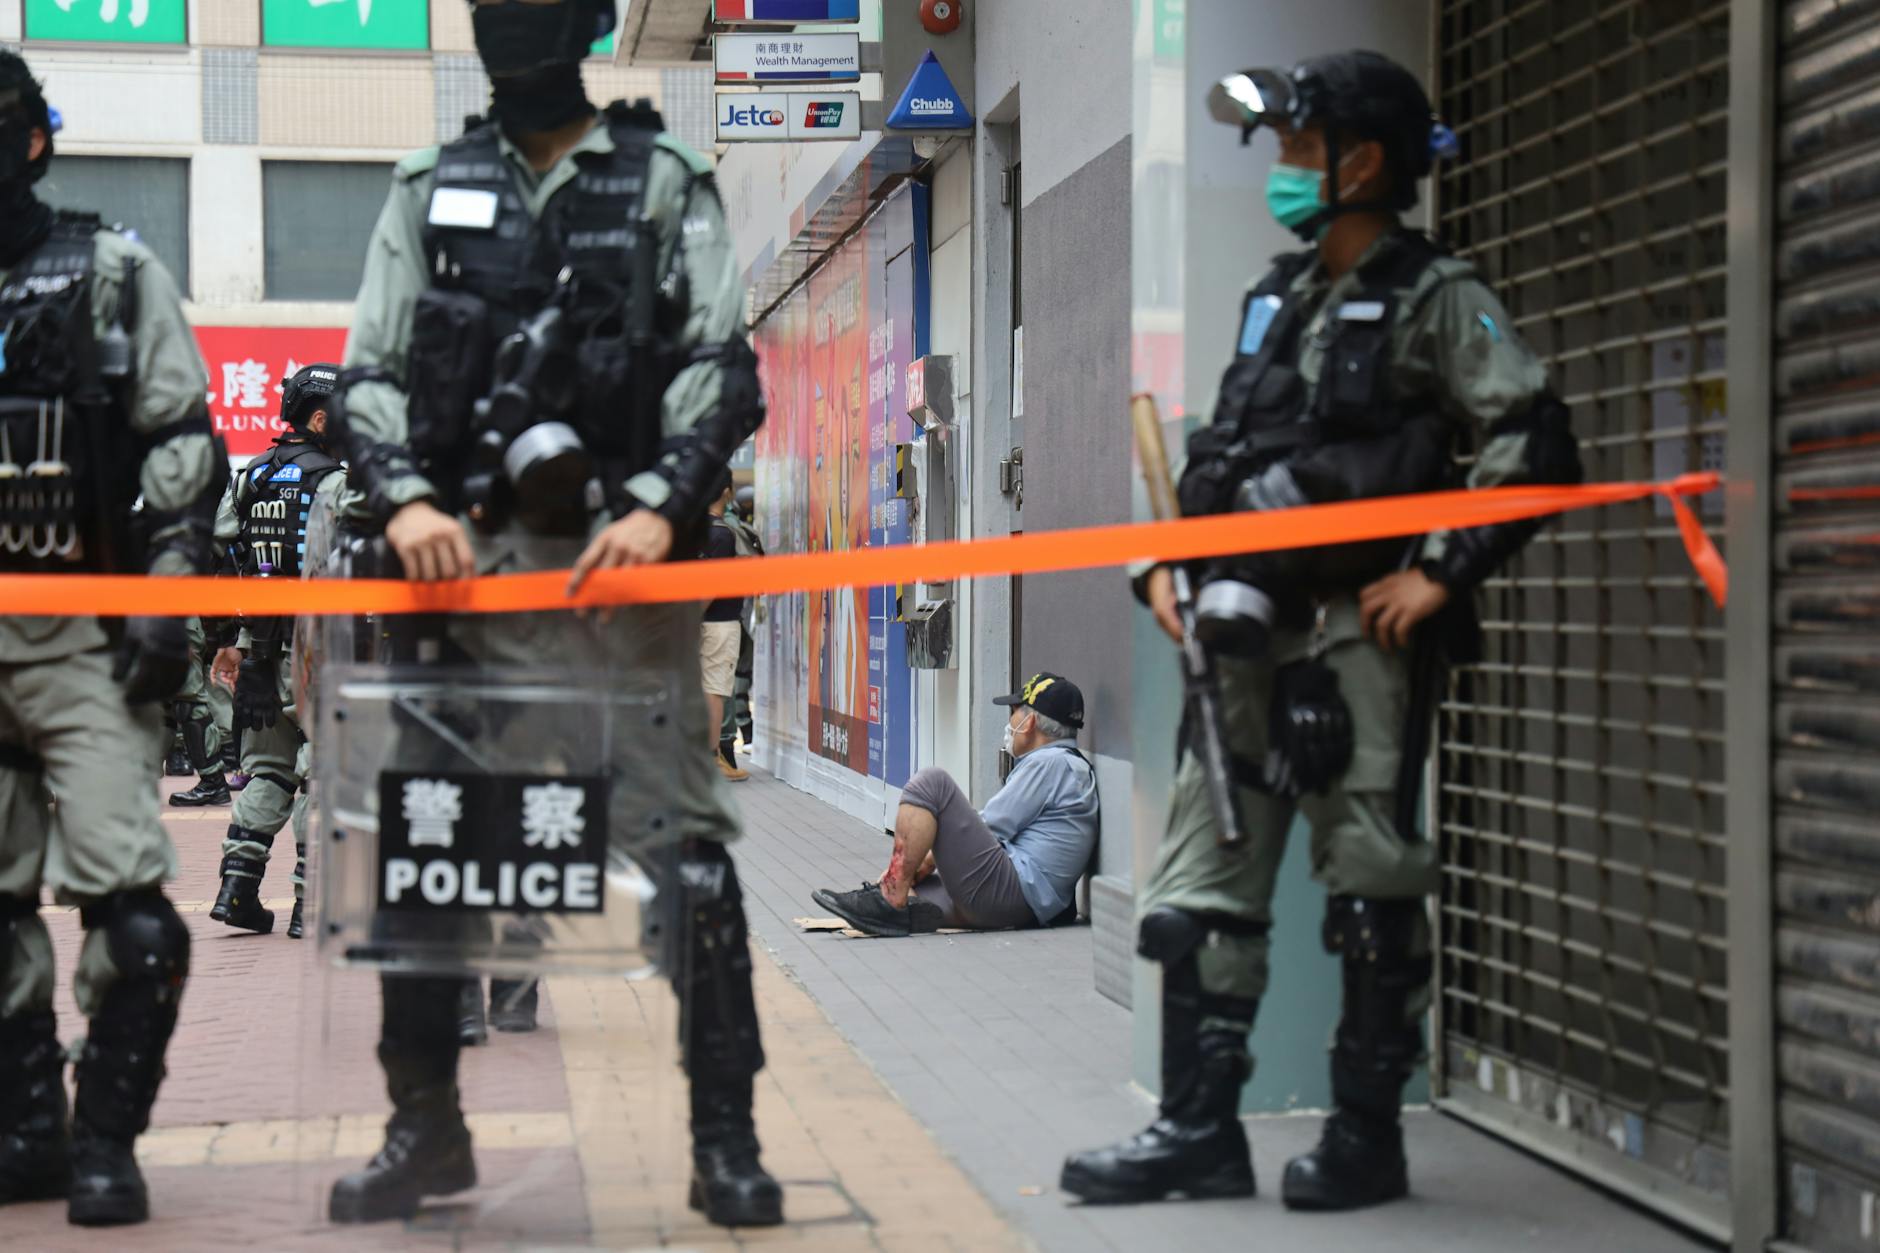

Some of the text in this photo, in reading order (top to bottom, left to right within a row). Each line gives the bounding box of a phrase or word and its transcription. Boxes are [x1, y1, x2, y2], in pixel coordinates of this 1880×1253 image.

[755, 42, 803, 54] 南商理財
[755, 55, 855, 67] Wealth Management
[910, 97, 954, 110] Chubb
[807, 107, 841, 118] UnionPay
[279, 487, 299, 500] SGT
[402, 778, 586, 850] 警察
[384, 858, 600, 908] POLICE
